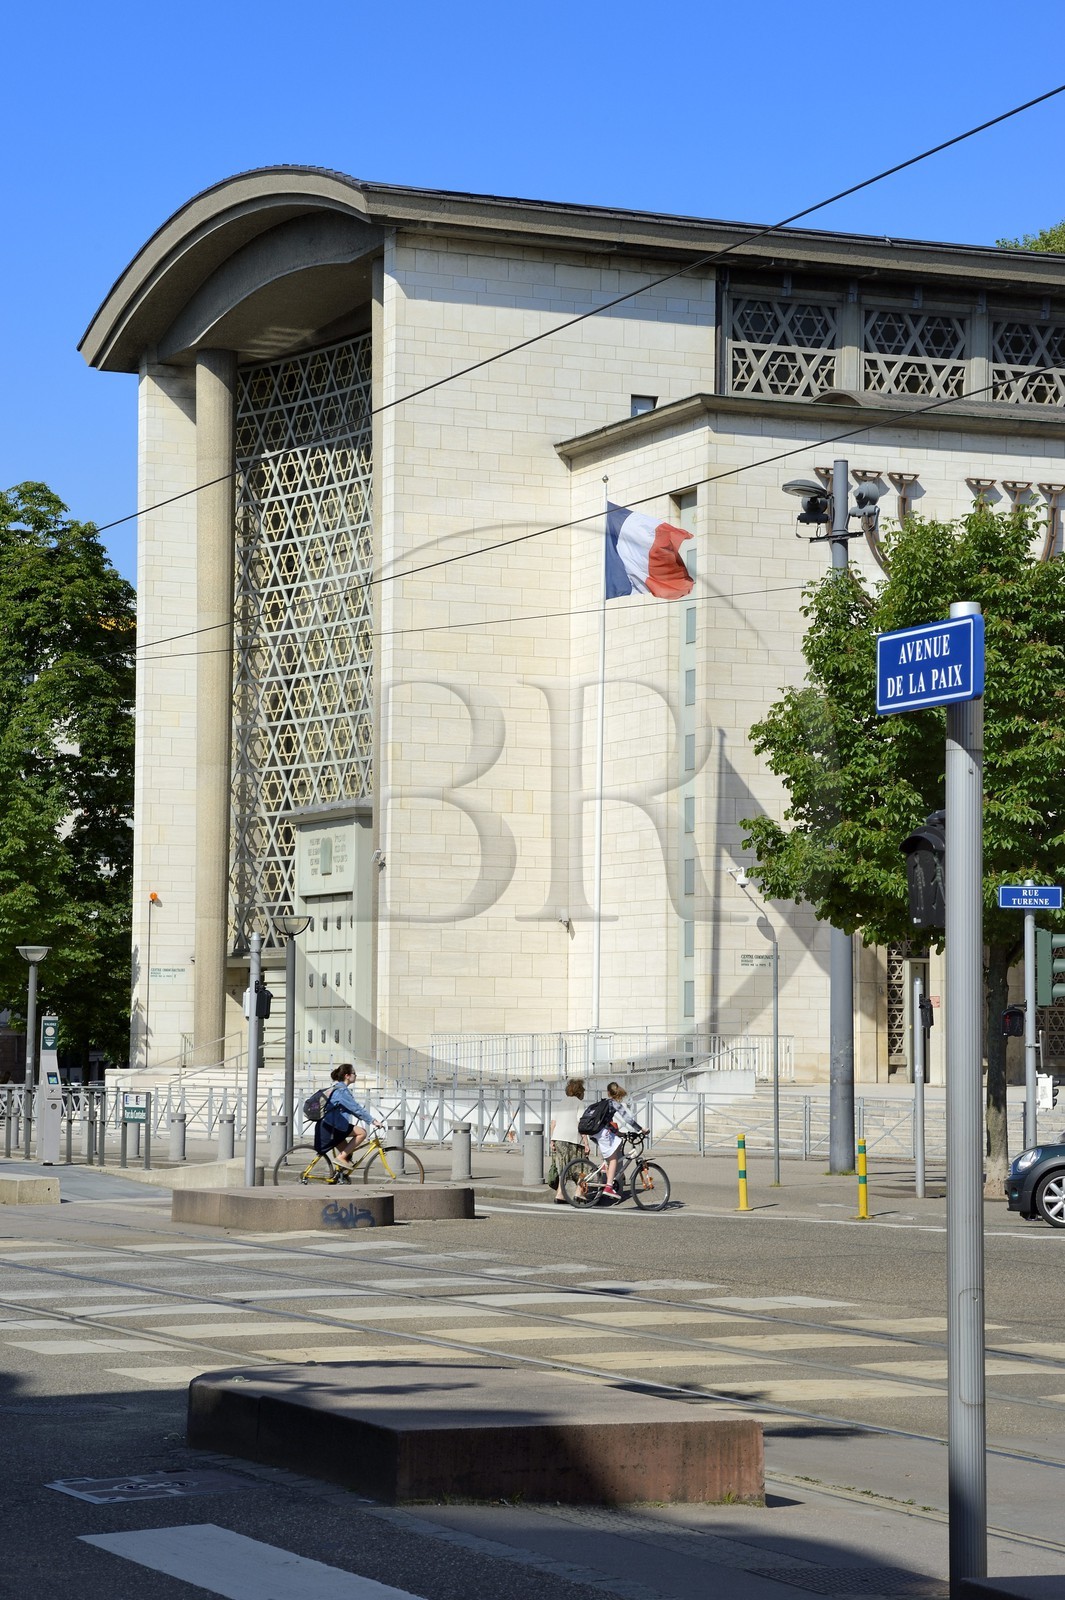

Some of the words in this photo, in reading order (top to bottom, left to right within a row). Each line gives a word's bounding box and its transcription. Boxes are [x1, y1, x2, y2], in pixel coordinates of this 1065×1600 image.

[898, 634, 950, 665] AVENUE
[886, 675, 904, 699] DE
[908, 671, 926, 695] LA
[931, 663, 963, 691] PAIX
[1011, 898, 1050, 906] TURENNE
[1022, 889, 1039, 897] RUE
